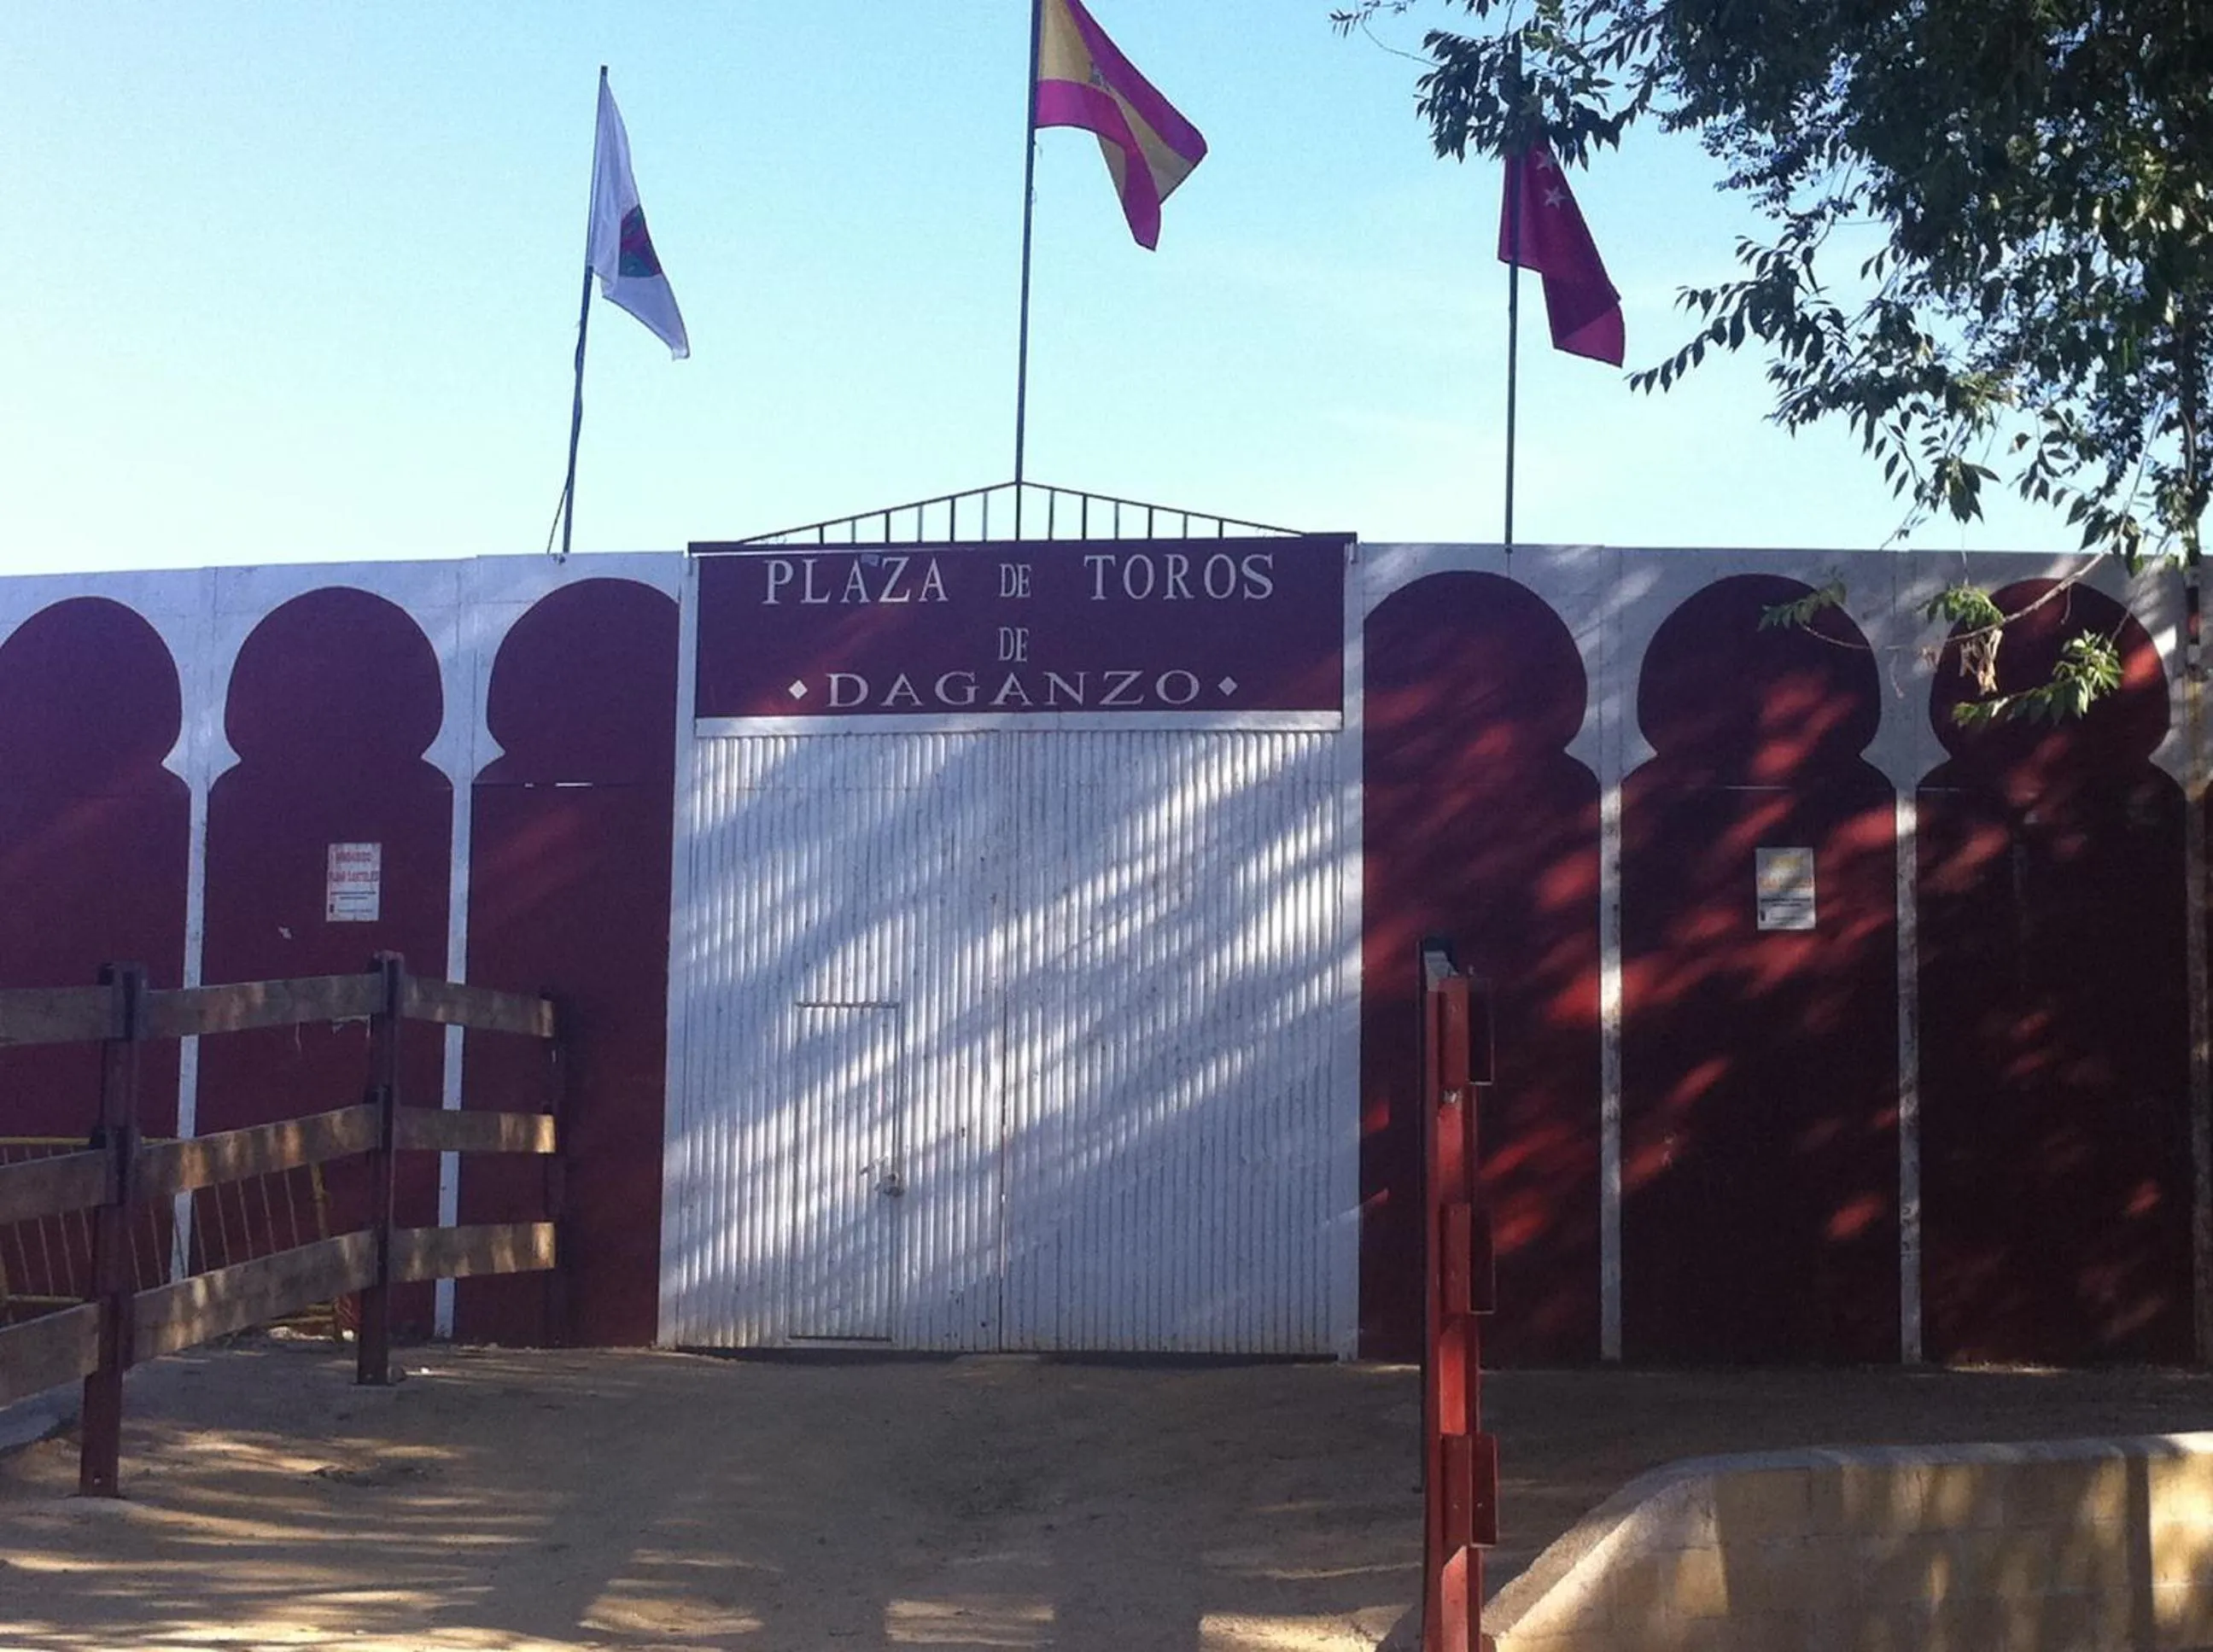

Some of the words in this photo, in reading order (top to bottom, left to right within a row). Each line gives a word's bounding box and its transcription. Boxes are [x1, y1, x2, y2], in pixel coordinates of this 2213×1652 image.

[762, 557, 949, 604] PLAZA
[1000, 563, 1031, 599] DE
[1084, 553, 1276, 601] TOROS
[998, 626, 1029, 663] DE
[827, 669, 1201, 708] DAGANZO
